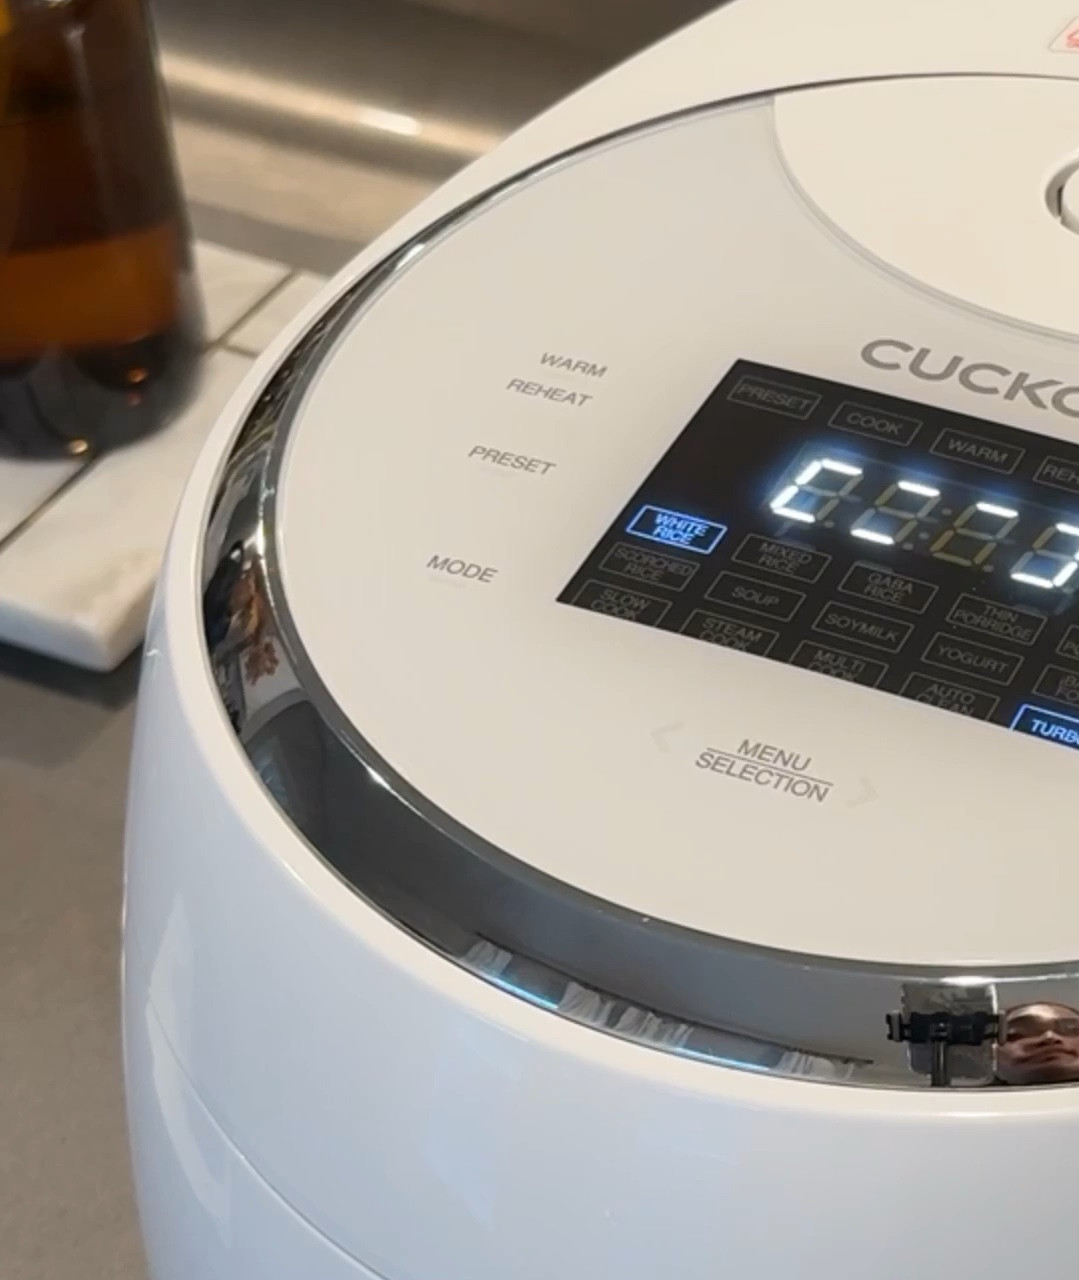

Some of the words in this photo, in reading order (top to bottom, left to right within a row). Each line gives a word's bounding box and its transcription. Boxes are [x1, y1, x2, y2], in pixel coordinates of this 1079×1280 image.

[540, 352, 607, 378] WARM
[506, 378, 593, 407] REHEAT
[736, 385, 811, 412] PRESET
[846, 411, 903, 436] COOK
[467, 445, 557, 476] PRESET
[947, 439, 1008, 464] WARM
[652, 525, 696, 545] RICE
[655, 513, 709, 537] WHITE
[758, 554, 796, 575] RICE
[760, 541, 813, 564] MIXED
[426, 554, 498, 584] MODE
[625, 564, 663, 583] RICE
[600, 588, 651, 611] SLOW
[731, 585, 780, 607] SOUP
[864, 585, 905, 606] RICE
[702, 618, 763, 643] STEAM
[825, 613, 898, 643] SOYMILK
[813, 649, 866, 673] MULTI
[938, 644, 1009, 673] YOGURT
[925, 683, 976, 705] AUTO
[737, 738, 812, 772] MENU
[695, 751, 830, 803] SELECTION
